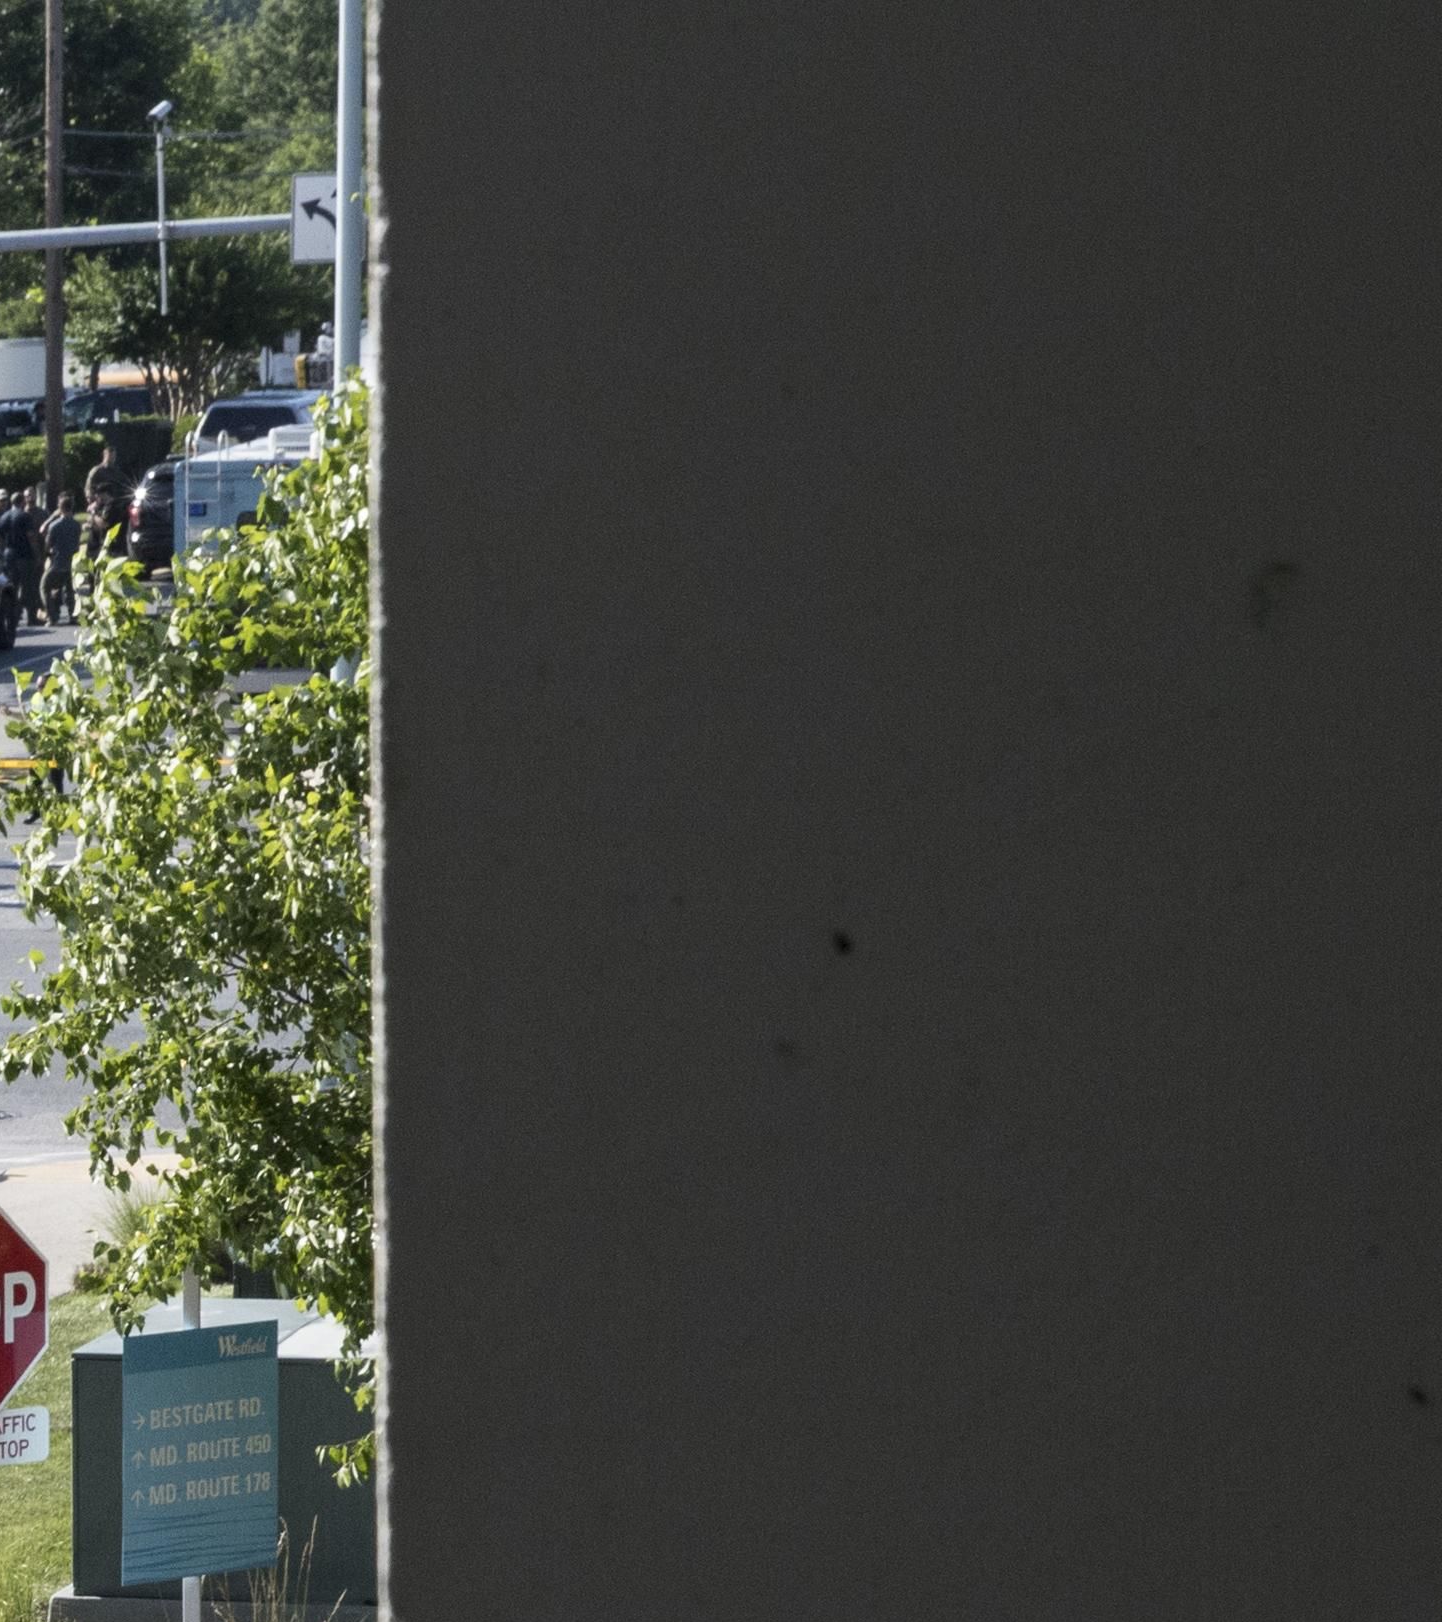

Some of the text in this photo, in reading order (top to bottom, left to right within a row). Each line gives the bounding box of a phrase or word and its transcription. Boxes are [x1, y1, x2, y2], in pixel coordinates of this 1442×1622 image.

[218, 1335, 268, 1357] Westfield
[150, 1397, 265, 1430] BESTGATE RD.
[149, 1434, 271, 1467] MD. ROUTE 450
[149, 1472, 271, 1505] MD. ROUTE 178
